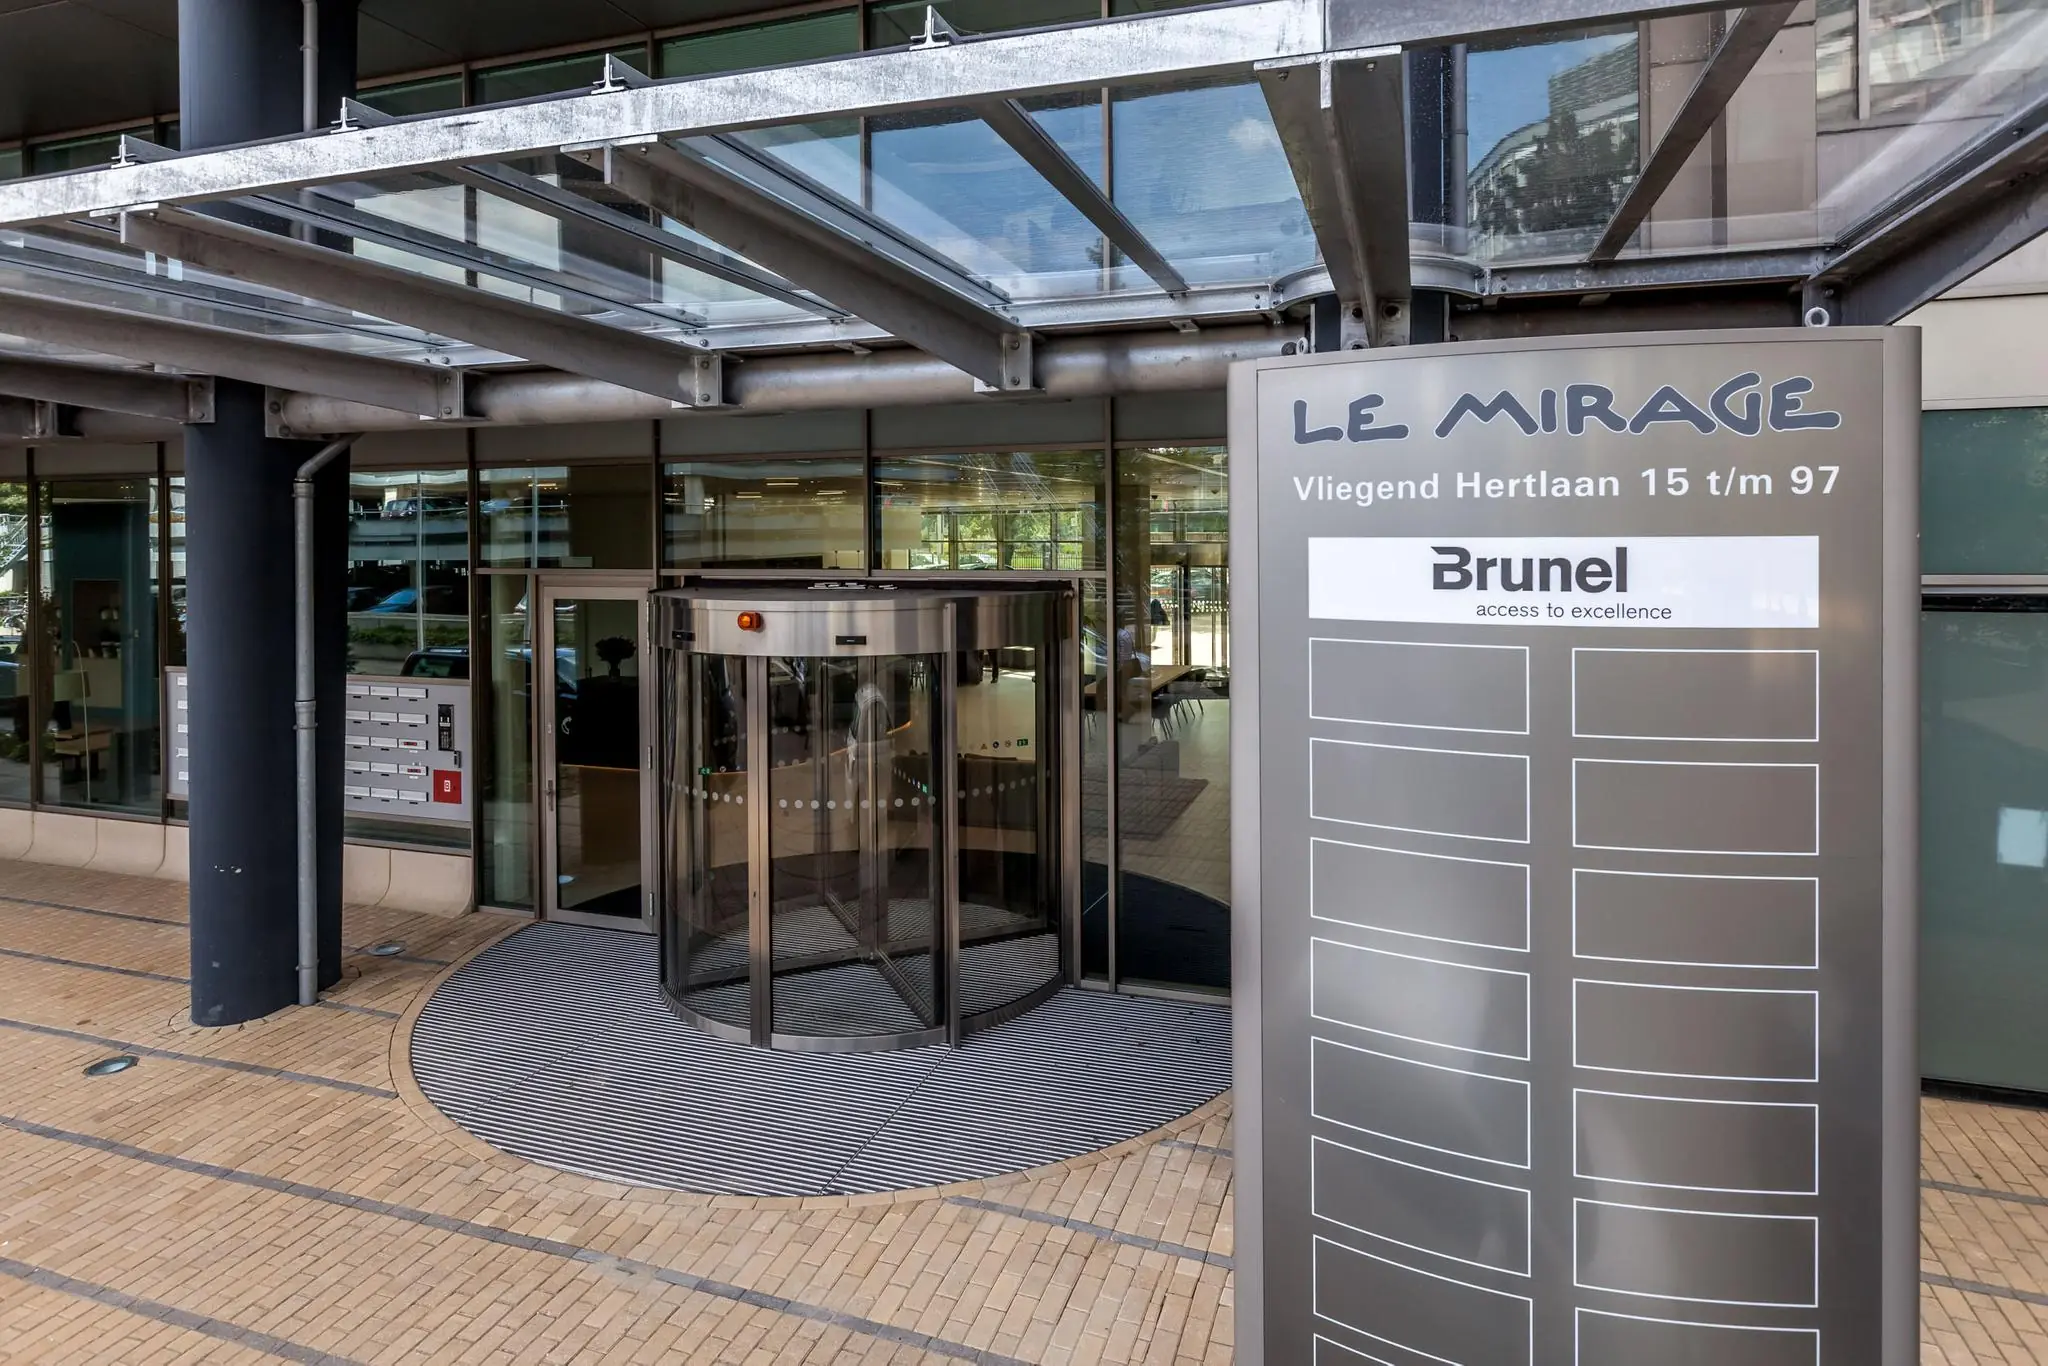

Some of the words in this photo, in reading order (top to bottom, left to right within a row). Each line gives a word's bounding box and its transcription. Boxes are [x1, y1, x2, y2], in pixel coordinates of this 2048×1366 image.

[1292, 393, 1410, 445] LE
[1434, 371, 1842, 440] MIRAGE
[1293, 473, 1440, 507] Vliegend
[1456, 470, 1620, 499] Hertlaan
[1641, 468, 1689, 496] 15
[1707, 467, 1772, 496] t/m
[1790, 465, 1841, 495] 97
[1430, 546, 1628, 593] Brunel
[1476, 604, 1539, 619] access
[1547, 603, 1565, 619] to
[1571, 602, 1672, 621] excellence
